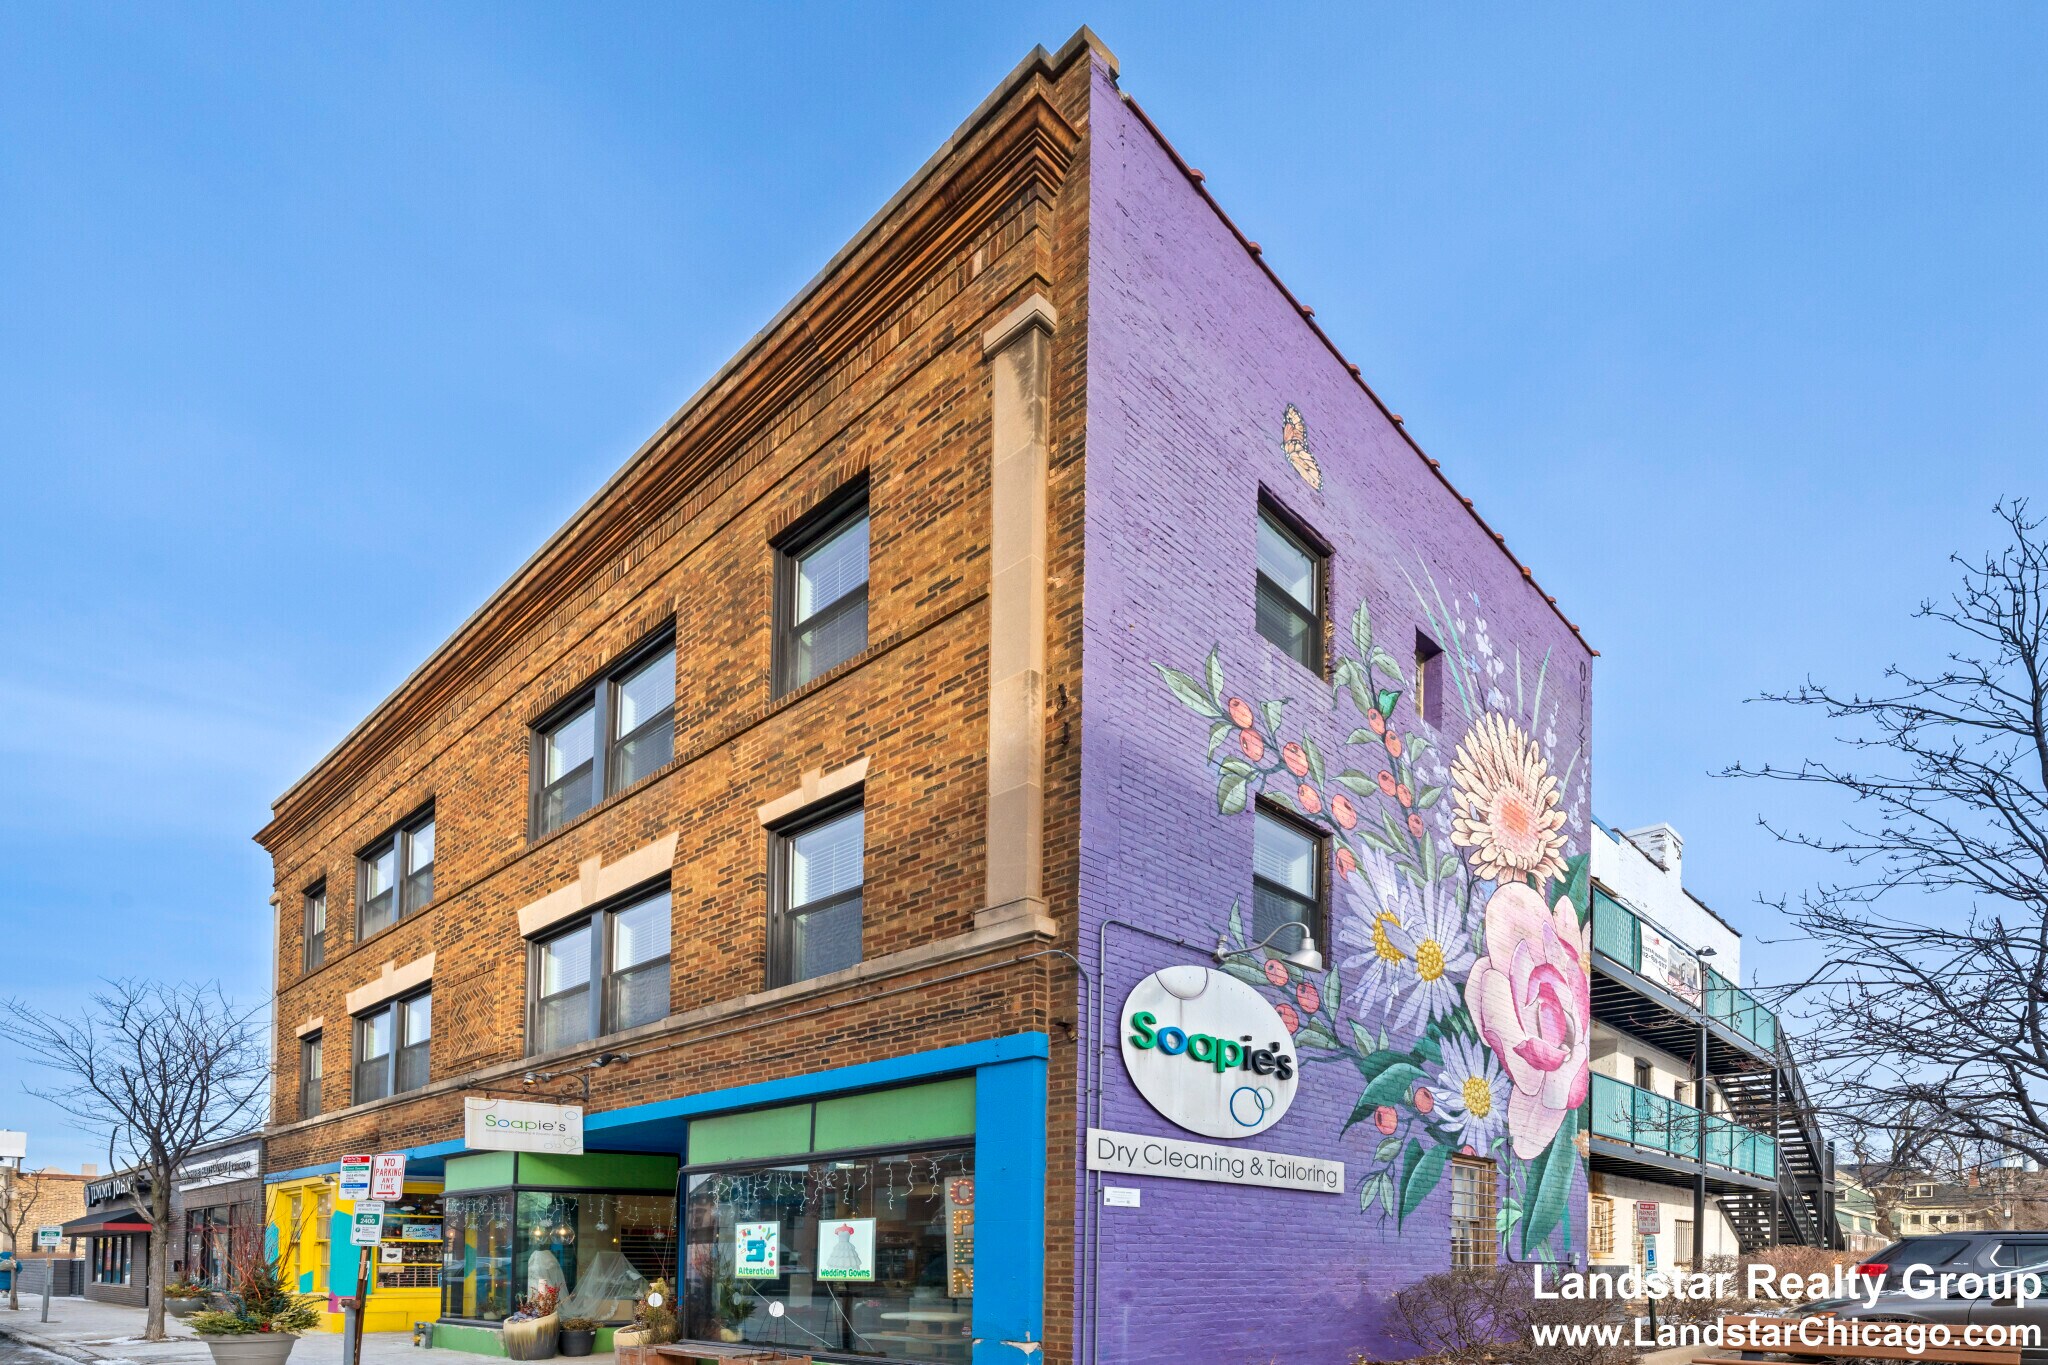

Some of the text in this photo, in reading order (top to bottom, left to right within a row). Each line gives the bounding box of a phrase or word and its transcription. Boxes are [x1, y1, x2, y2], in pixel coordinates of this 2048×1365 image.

[1131, 1011, 1293, 1080] Soapie's
[485, 1114, 566, 1131] Soapie's
[383, 1158, 396, 1167] NO
[1098, 1137, 1337, 1188] Dry Cleaning & Tailoring
[375, 1168, 402, 1177] PARKING
[90, 1181, 112, 1204] JIMMY
[950, 1178, 974, 1294] OPEN
[738, 1267, 774, 1275] Alteration
[821, 1268, 870, 1277] Wedding Gowns
